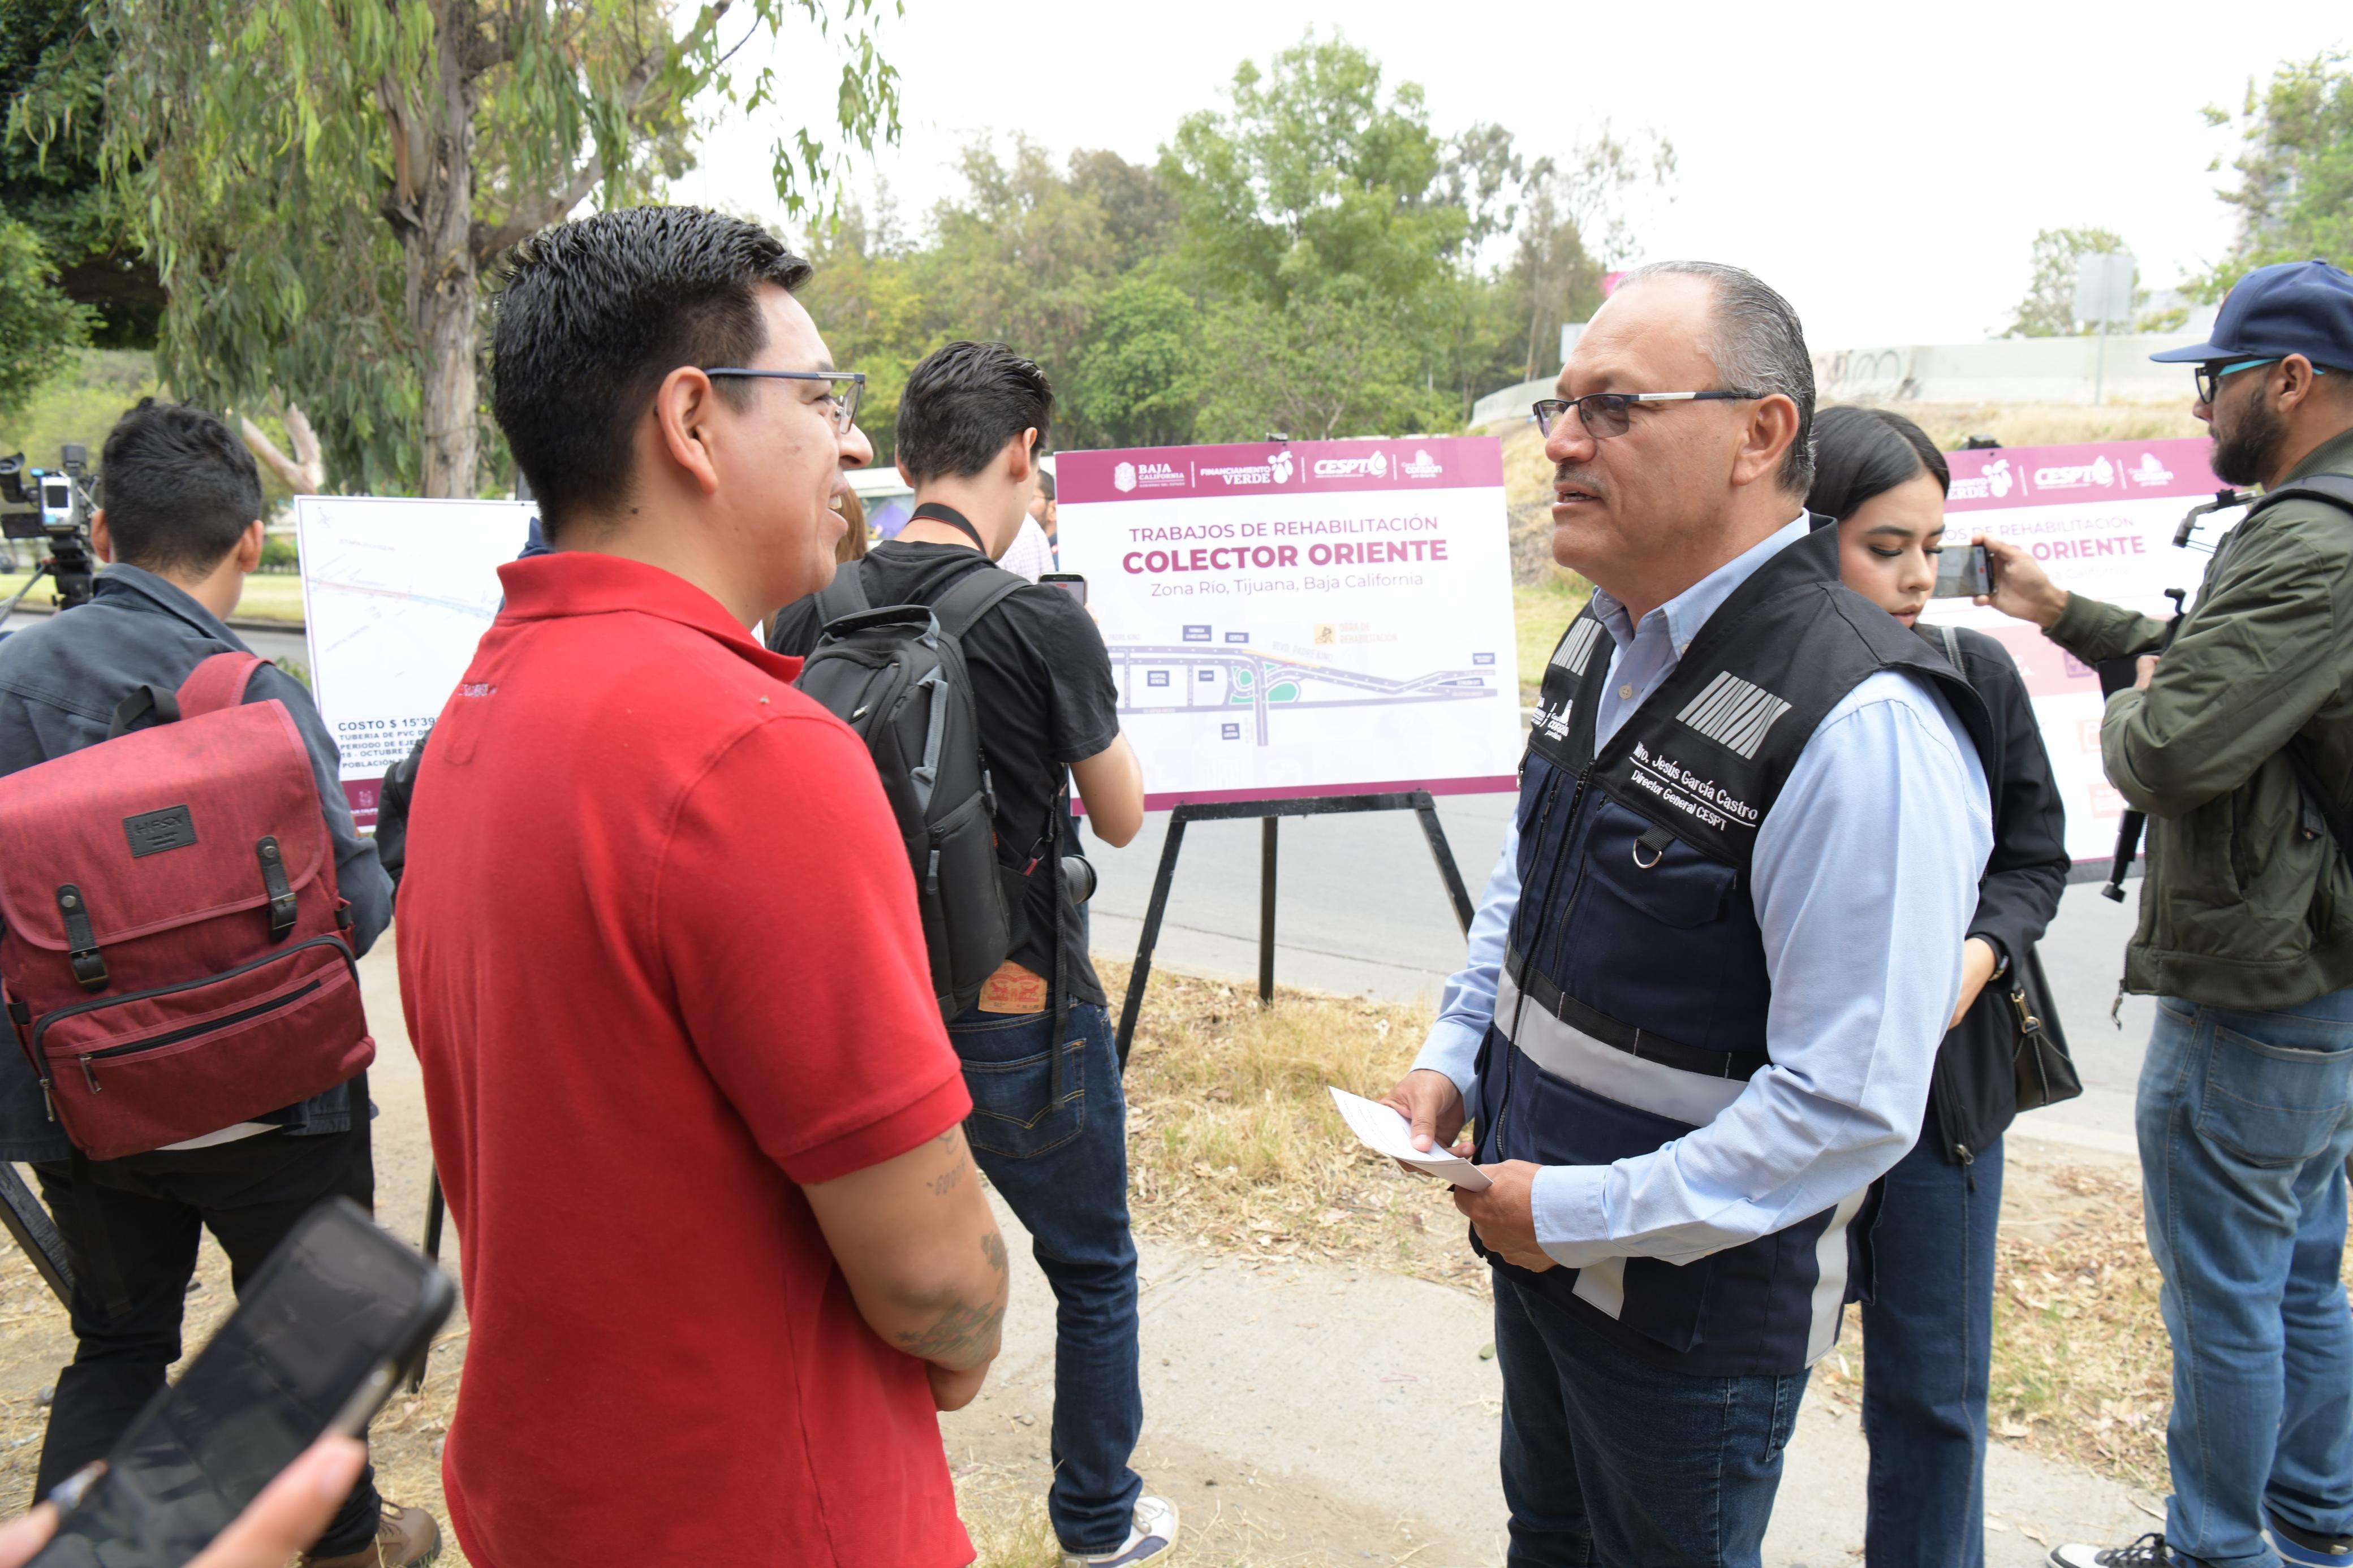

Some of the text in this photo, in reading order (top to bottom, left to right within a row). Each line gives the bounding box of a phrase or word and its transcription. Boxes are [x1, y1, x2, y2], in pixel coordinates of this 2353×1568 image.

[1139, 463, 1171, 474] BAJA
[1200, 466, 1271, 476] FINANCIAMIENTO
[1314, 459, 1370, 474] CESPT
[1223, 473, 1270, 485] VERDE
[1129, 513, 1438, 542] TRABAJOS DE REHABILITACIÓN
[1123, 539, 1448, 574] COLECTOR ORIENTE
[2032, 535, 2145, 561] ORIENTE
[1150, 573, 1423, 597] Zona Río, Tijuana, Baja California
[338, 720, 385, 731] COSTO
[390, 719, 397, 728] $
[360, 748, 403, 757] OCTUBRE
[1652, 755, 1681, 779] Jesús
[1681, 770, 1716, 800] García
[1716, 789, 1758, 820] Castro
[1631, 770, 1727, 831] Director General CESPT
